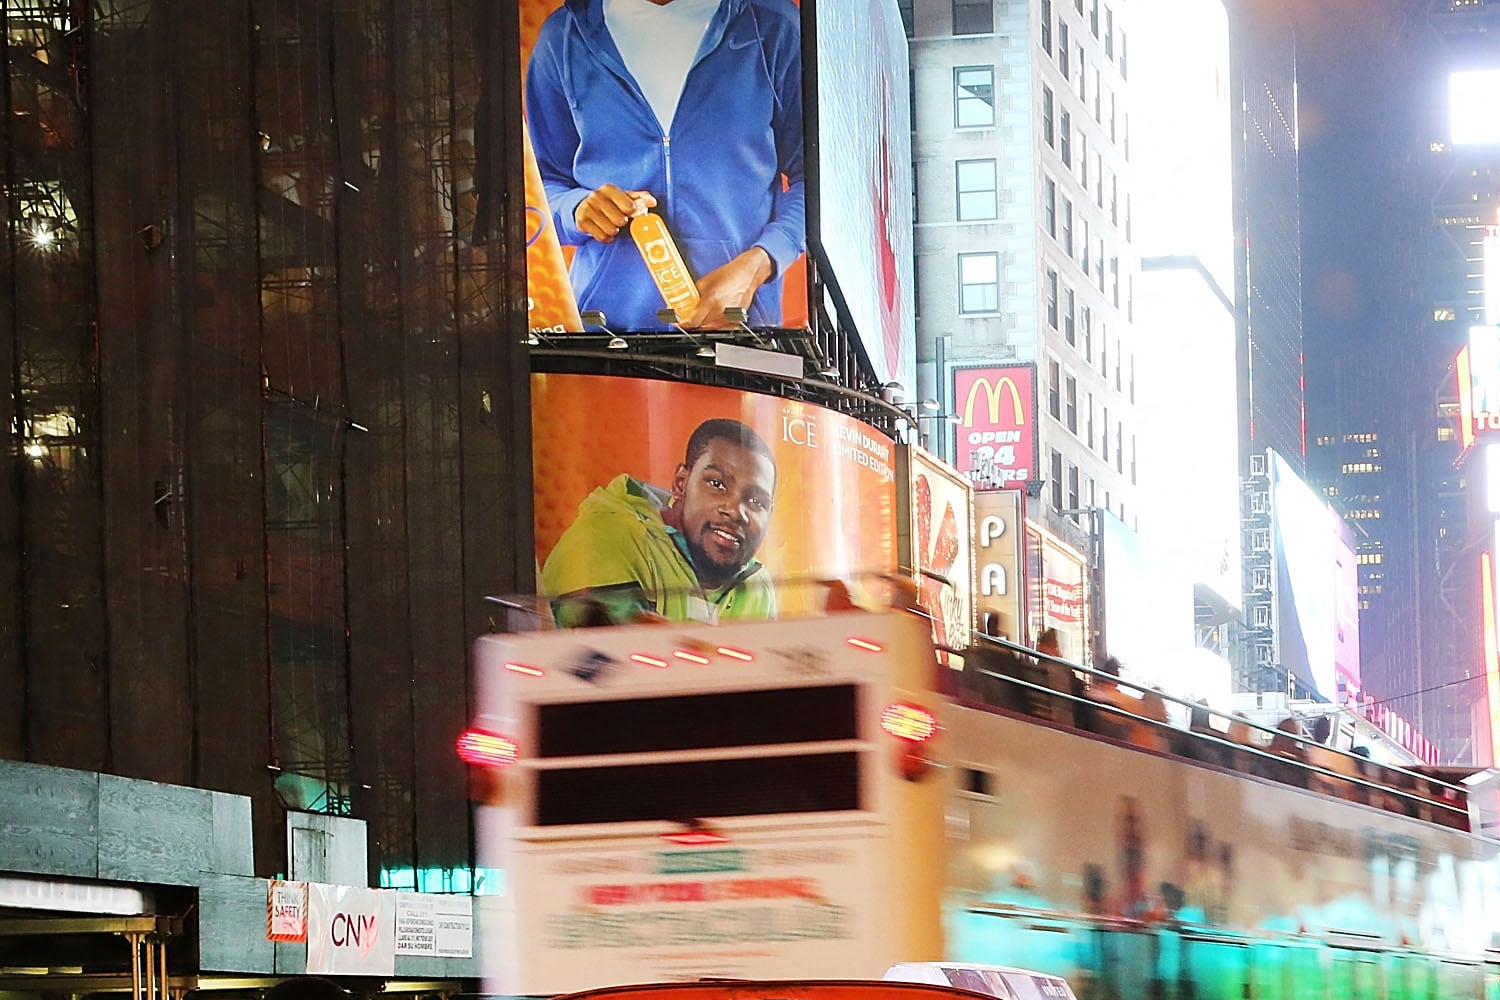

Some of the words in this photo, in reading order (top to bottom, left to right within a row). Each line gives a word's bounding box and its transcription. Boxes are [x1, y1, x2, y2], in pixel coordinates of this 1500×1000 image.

[782, 415, 817, 448] ICE
[968, 430, 1021, 445] OPEN
[863, 438, 890, 462] DURANT
[275, 904, 300, 919] SAFETY
